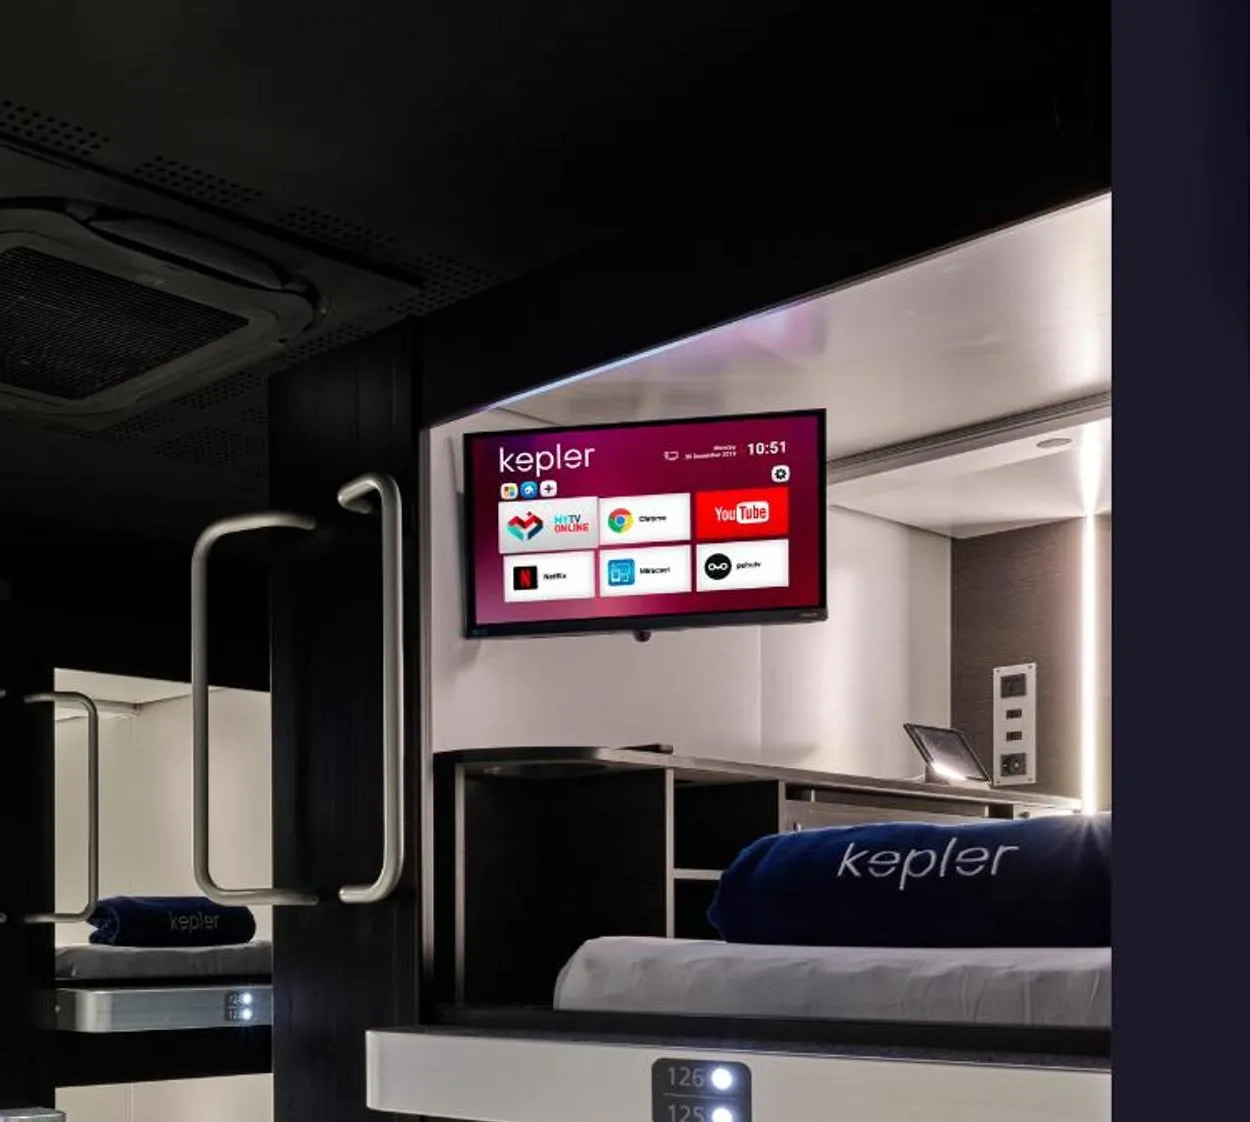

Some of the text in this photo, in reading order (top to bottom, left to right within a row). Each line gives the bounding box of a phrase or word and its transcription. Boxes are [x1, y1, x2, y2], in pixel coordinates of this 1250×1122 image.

[747, 441, 787, 456] 10:51
[499, 443, 596, 478] kepler
[714, 502, 768, 523] YouTube
[554, 523, 589, 534] ONLINE
[837, 837, 1020, 891] kepler
[168, 911, 220, 933] kepler
[667, 1066, 705, 1088] 126
